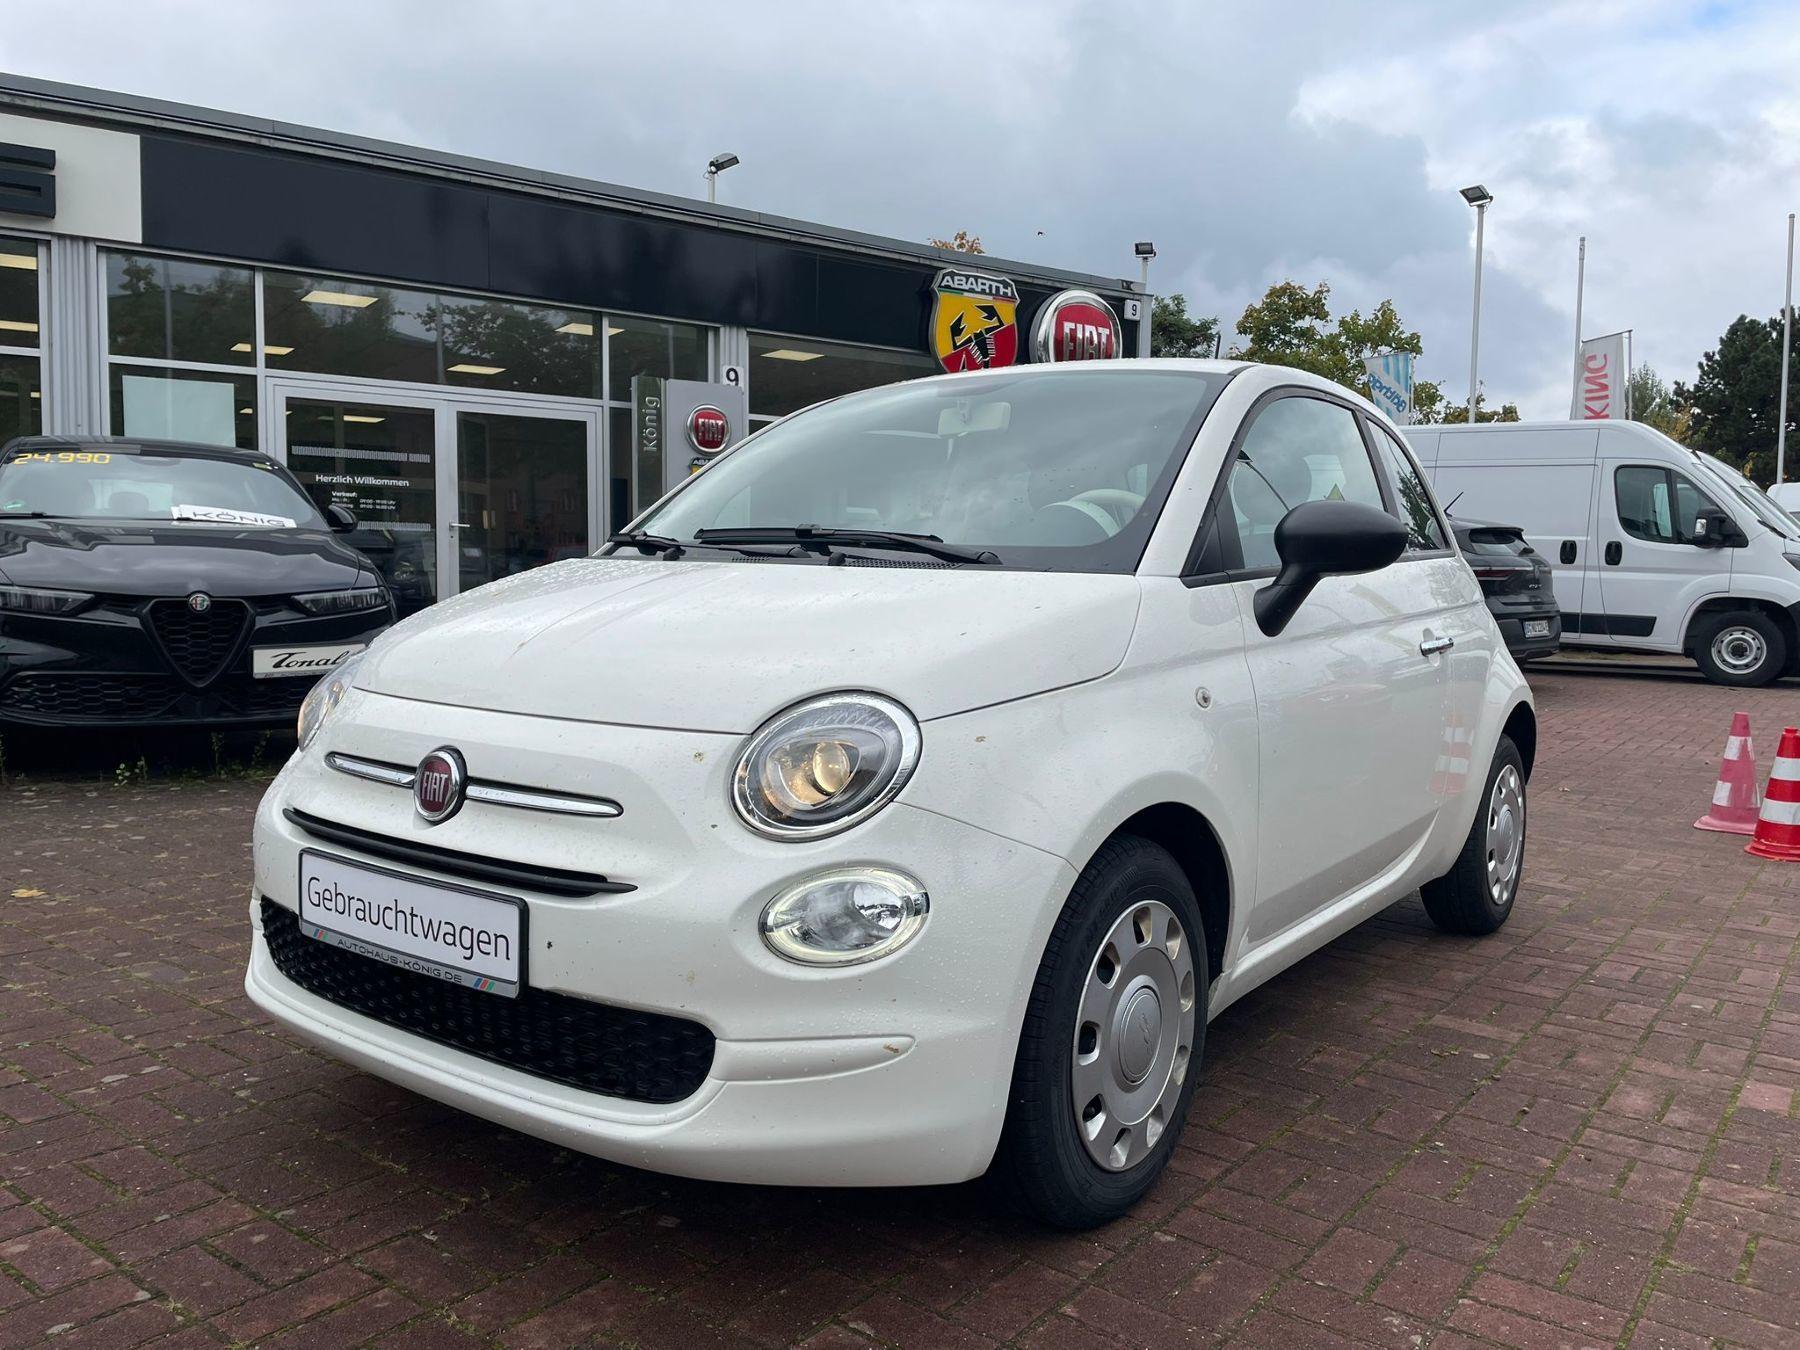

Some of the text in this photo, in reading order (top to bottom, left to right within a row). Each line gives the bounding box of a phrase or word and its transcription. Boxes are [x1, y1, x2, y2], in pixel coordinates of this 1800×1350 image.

[941, 275, 1012, 297] ABARTH
[1131, 303, 1138, 317] 9
[1063, 321, 1110, 362] FIAT
[725, 367, 740, 387] 9
[642, 396, 660, 452] König
[698, 418, 724, 441] FIAT
[12, 452, 112, 465] 24.990
[315, 474, 410, 487] Herzlich Willkommen
[192, 511, 287, 528] KÖNIG
[271, 650, 350, 669] Tonal
[421, 771, 449, 803] FIAT
[307, 876, 511, 961] Gebrauchtwagen
